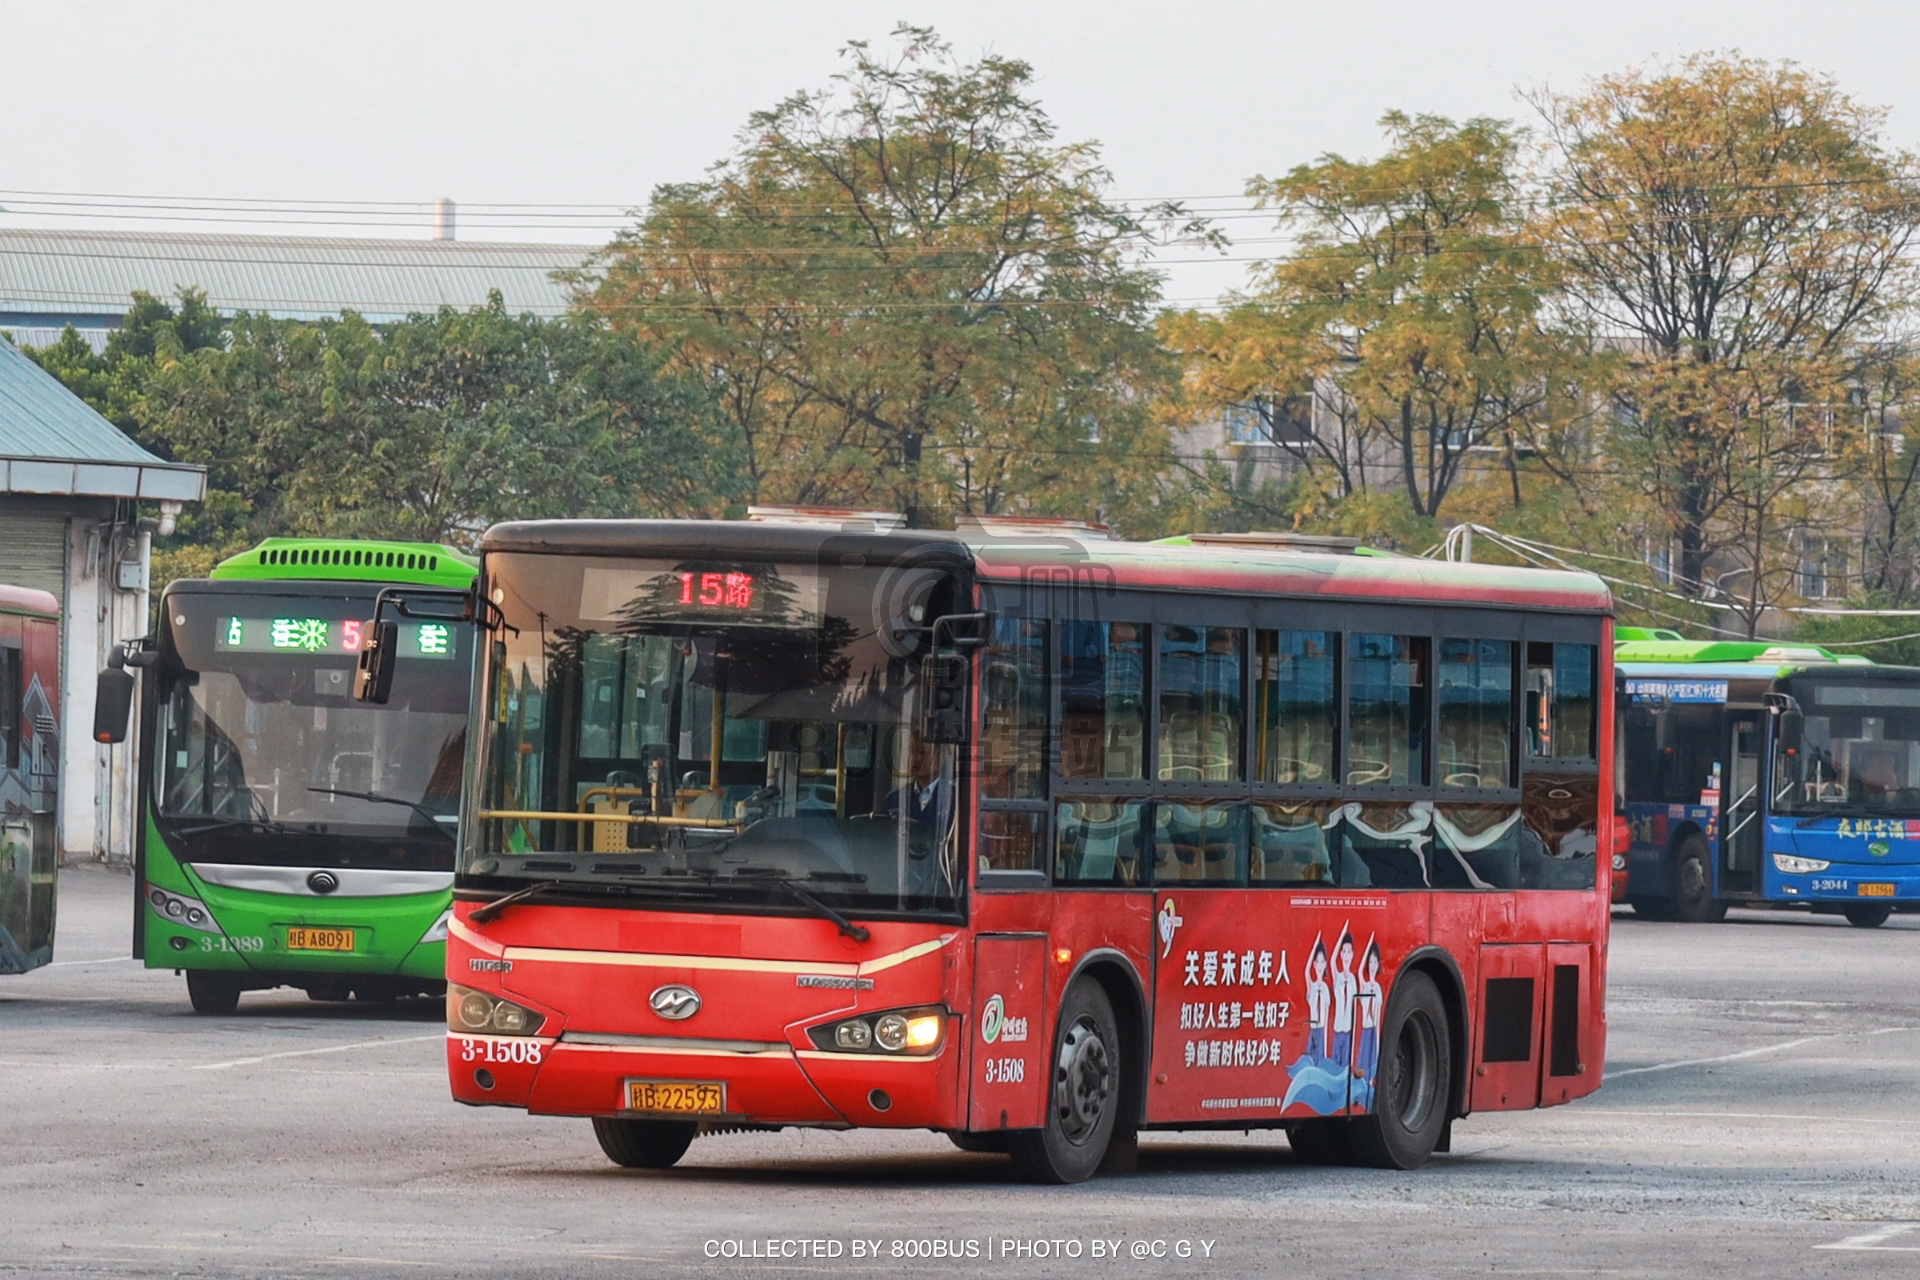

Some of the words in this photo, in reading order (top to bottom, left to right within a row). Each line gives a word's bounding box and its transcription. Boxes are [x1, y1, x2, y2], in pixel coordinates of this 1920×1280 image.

[678, 571, 754, 608] 15路
[470, 958, 513, 973] HIGER
[1184, 950, 1290, 986] 关爱未成年人
[1180, 1001, 1290, 1030] 扣好人生第一粒扣子
[462, 1038, 542, 1064] 3-1508
[1185, 1038, 1281, 1067] 争做新时代好少年
[985, 1058, 1025, 1083] 3-1508
